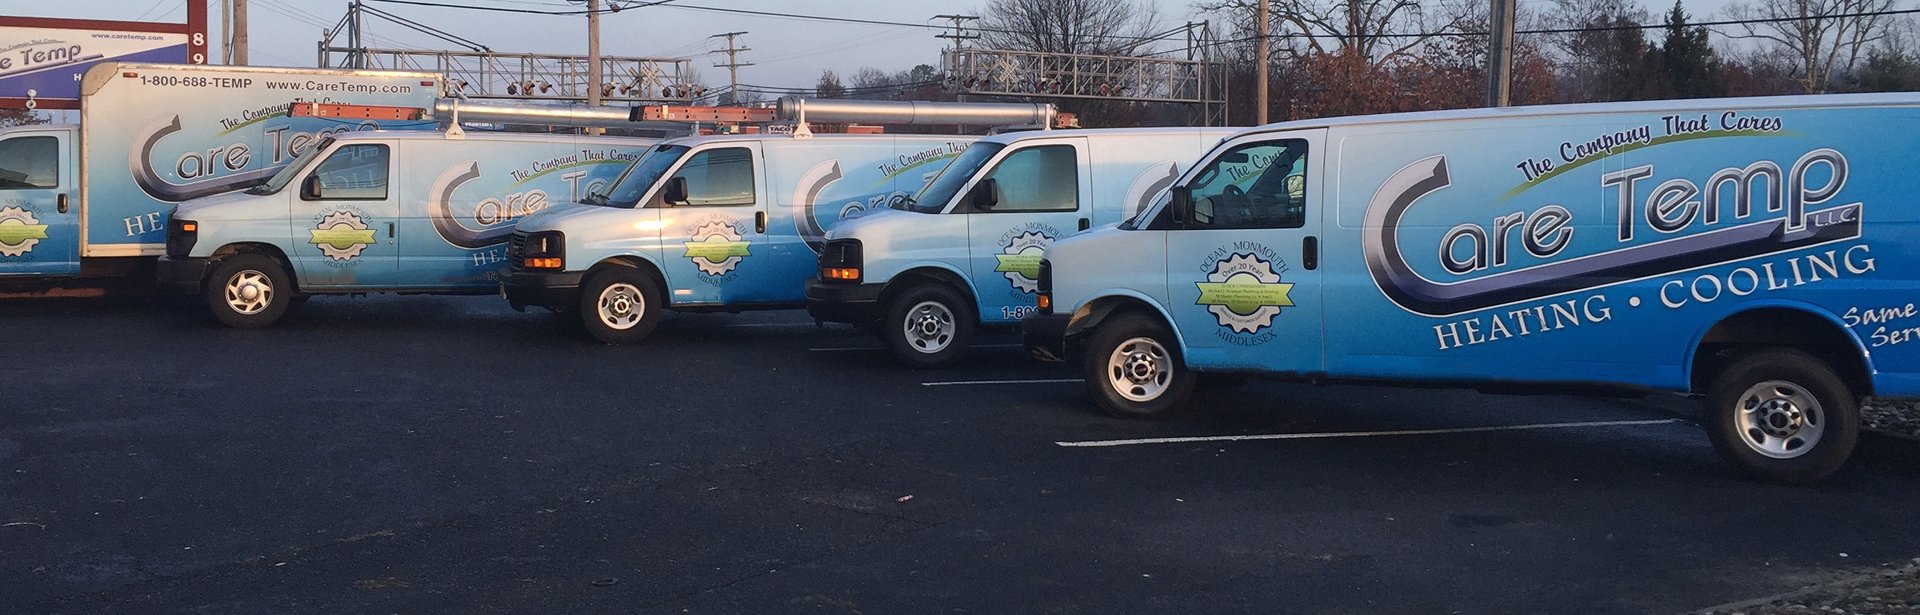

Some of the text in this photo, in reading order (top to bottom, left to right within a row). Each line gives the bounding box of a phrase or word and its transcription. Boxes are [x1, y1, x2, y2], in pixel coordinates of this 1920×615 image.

[91, 33, 164, 41] www.caretemp.com
[20, 44, 81, 65] Temp
[140, 75, 411, 94] 1-800-688-TEMP www.CareTemp.com
[220, 118, 240, 131] The
[242, 102, 291, 121] Company
[129, 112, 250, 203] Care
[1515, 111, 1783, 183] The Company That Cares
[510, 169, 530, 182] The
[532, 153, 578, 172] Company
[582, 149, 605, 161] That
[879, 164, 898, 177] The
[899, 147, 943, 167] Company
[1226, 165, 1251, 182] The
[429, 159, 548, 249] Care
[997, 225, 1020, 248] OCEAN
[1362, 153, 1574, 317] Care
[1601, 147, 1849, 243] Temp
[1199, 240, 1289, 274] OCEAN MONMOUTH
[1222, 262, 1265, 278] Over 20 Years
[1433, 243, 1876, 351] HEATING COOLING
[1843, 303, 1918, 328] Same
[1215, 328, 1277, 347] MIDDLESEX
